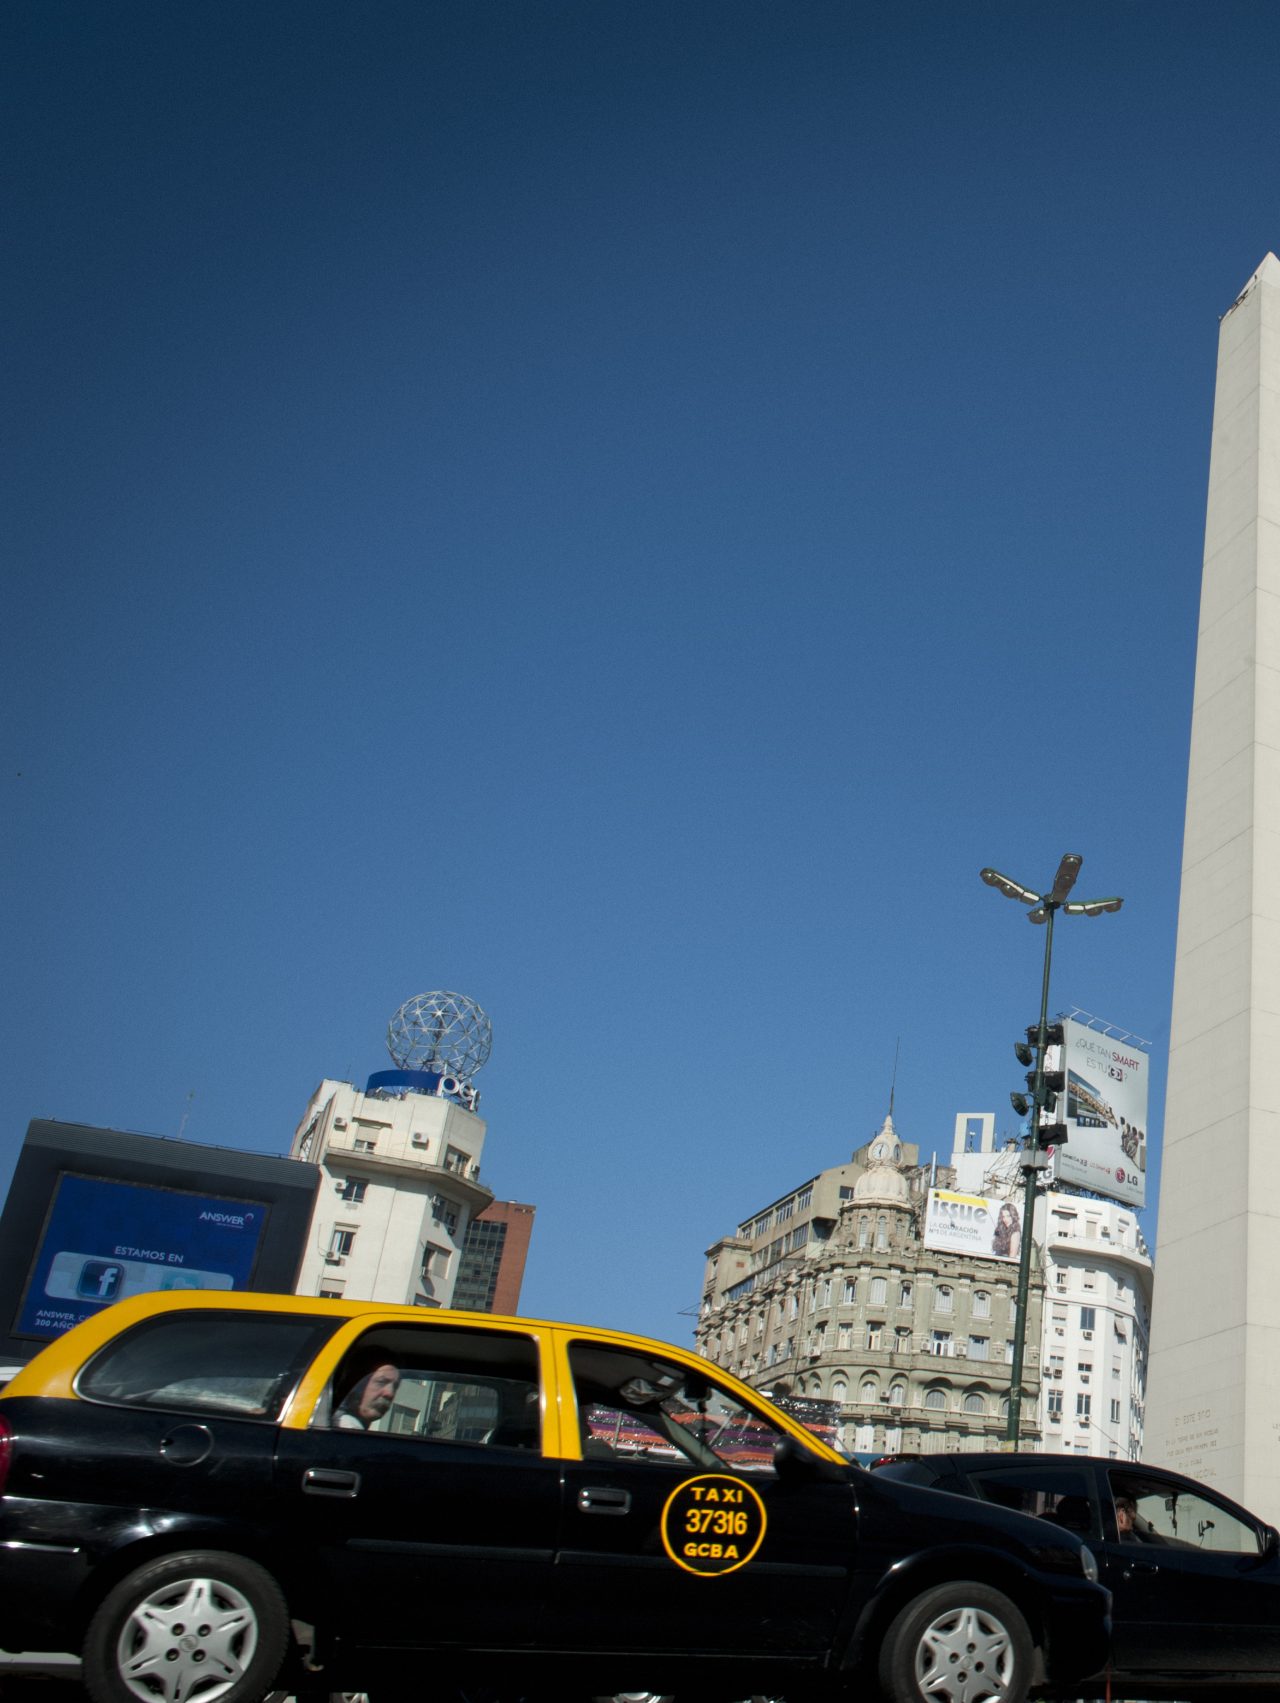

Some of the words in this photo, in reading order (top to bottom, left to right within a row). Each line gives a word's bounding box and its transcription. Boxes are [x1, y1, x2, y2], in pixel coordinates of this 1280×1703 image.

[1112, 1051, 1140, 1071] SMART
[1127, 1174, 1138, 1186] LG
[933, 1192, 988, 1224] issue
[199, 1211, 245, 1226] ANSWER
[114, 1245, 165, 1262] ESTAMOS
[168, 1253, 184, 1264] EN
[35, 1318, 51, 1328] 300
[690, 1487, 743, 1503] TAXI
[685, 1508, 748, 1535] 37316
[683, 1542, 739, 1559] GCBA
